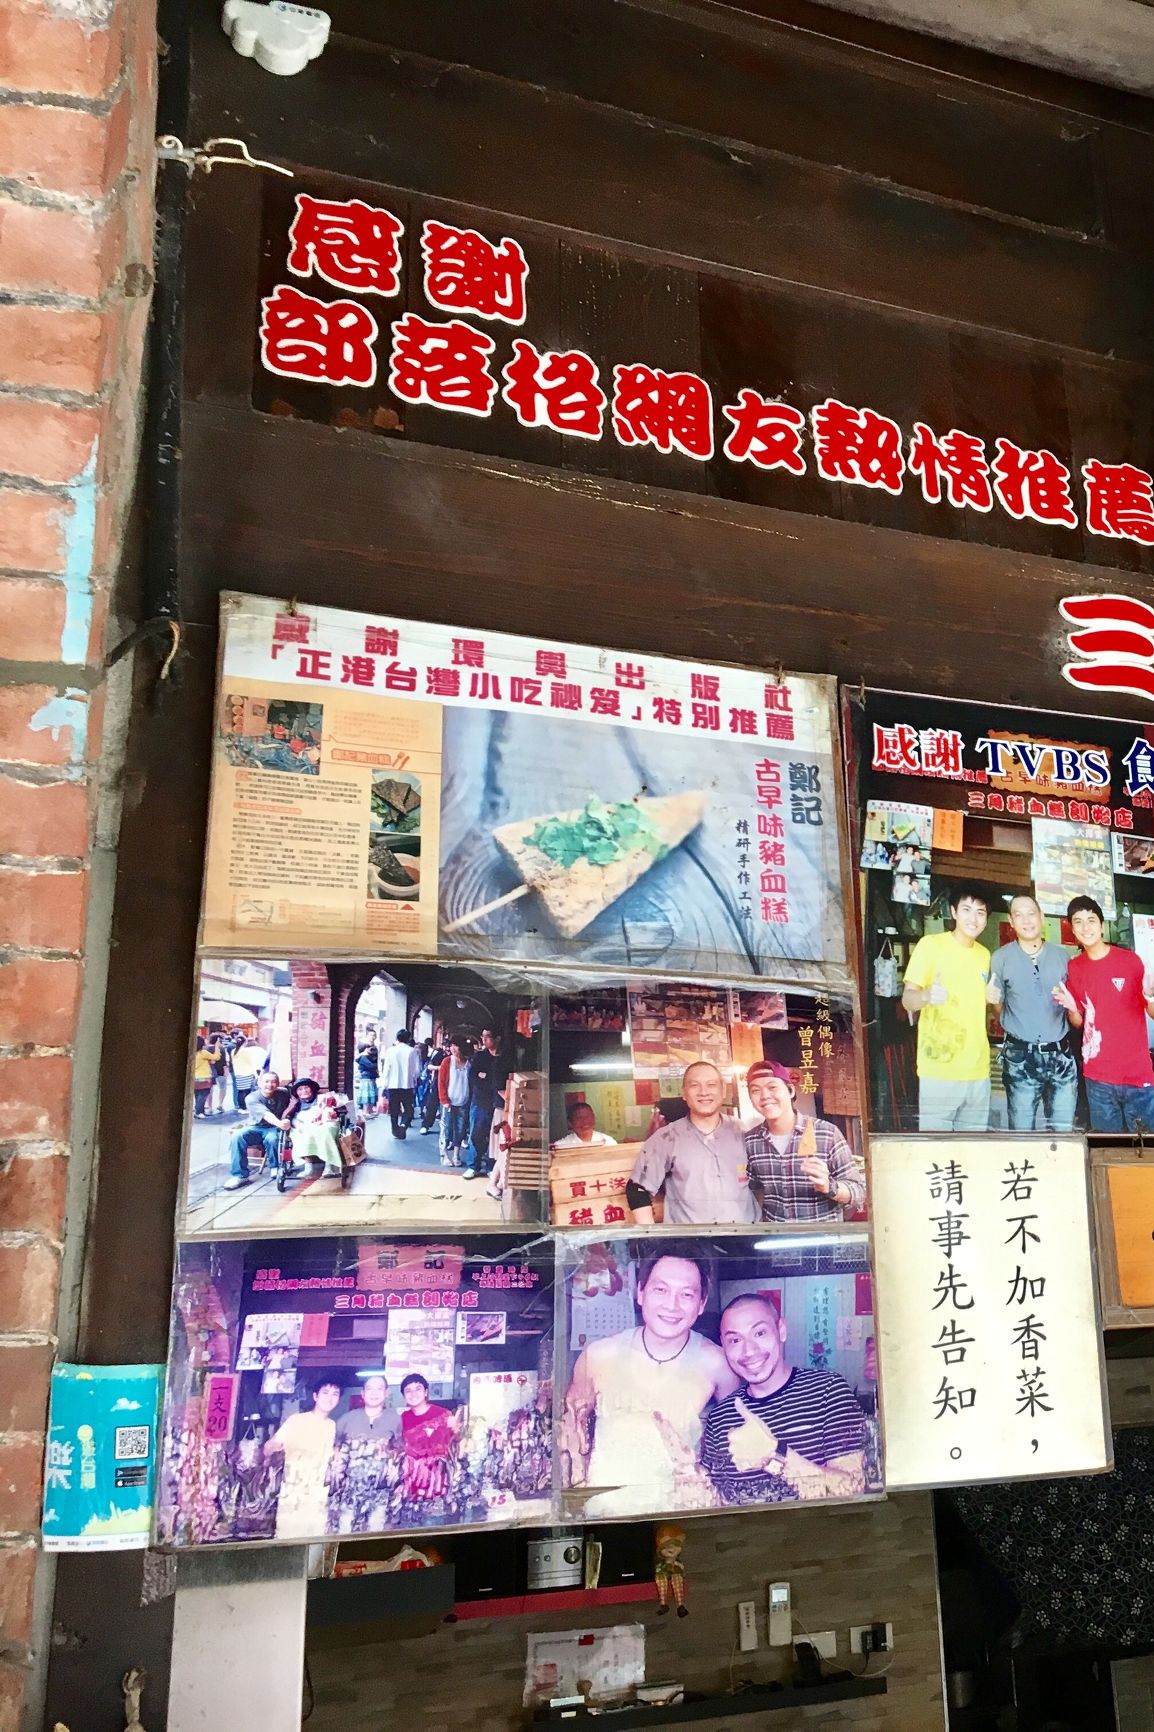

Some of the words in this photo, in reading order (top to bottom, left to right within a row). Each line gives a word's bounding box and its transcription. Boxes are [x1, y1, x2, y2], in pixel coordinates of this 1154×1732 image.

[287, 193, 529, 326] 感謝
[788, 762, 824, 827] 鄭記
[872, 722, 965, 776] 感謝
[975, 736, 1111, 788] TVBS
[735, 818, 753, 921] 精研手作工法
[755, 758, 789, 924] 古早味豬血糕
